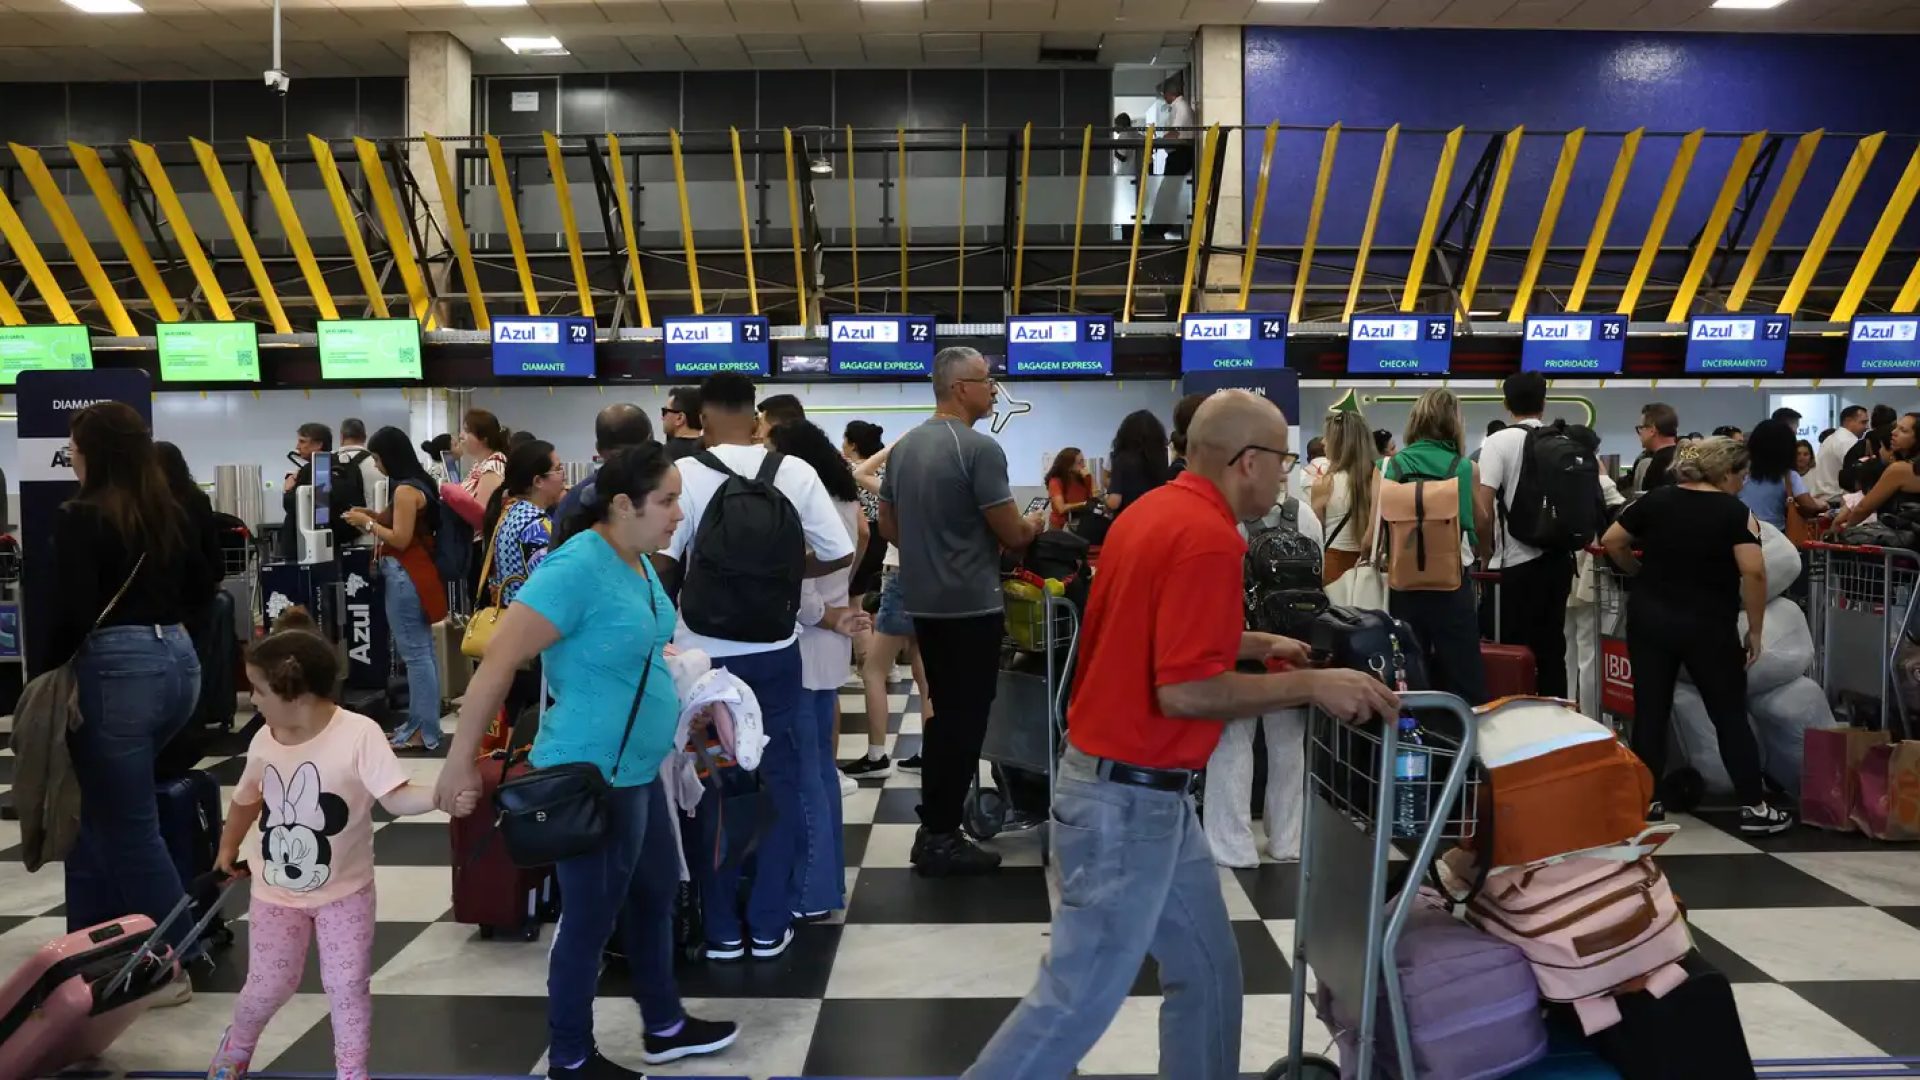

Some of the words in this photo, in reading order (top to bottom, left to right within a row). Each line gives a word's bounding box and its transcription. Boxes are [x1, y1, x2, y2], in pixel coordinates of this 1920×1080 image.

[500, 326, 536, 340] Azul
[570, 326, 587, 337] 70
[671, 326, 709, 340] Azul
[744, 324, 760, 337] 71
[837, 325, 874, 340] Azul
[911, 324, 928, 337] 72
[1015, 325, 1053, 340] Azul
[1089, 323, 1106, 336] 73
[1190, 323, 1227, 337] Azul
[1263, 321, 1280, 333] 74
[1357, 323, 1395, 338] Azul
[1430, 323, 1446, 335] 75
[1531, 323, 1569, 338] Azul
[1603, 323, 1620, 335] 76
[1695, 323, 1733, 338] Azul
[1767, 322, 1783, 335] 77
[1857, 324, 1895, 339] Azul
[522, 362, 565, 371] DIAMANTE
[675, 362, 717, 371] BAGAGEM
[720, 362, 760, 371] EXPRESSA
[839, 361, 881, 370] BAGAGEM
[884, 361, 925, 370] EXPRESSA
[1017, 361, 1059, 370] BAGAGEM
[1062, 361, 1103, 370] EXPRESSA
[1213, 359, 1253, 367] CHECK-IN
[1379, 360, 1418, 368] CHECK-IN
[1544, 359, 1599, 368] PRIORIDADES
[1702, 359, 1768, 368] ENCERRAMENTO
[1861, 360, 1920, 368] ENCERRAMENT
[347, 604, 371, 665] Azul
